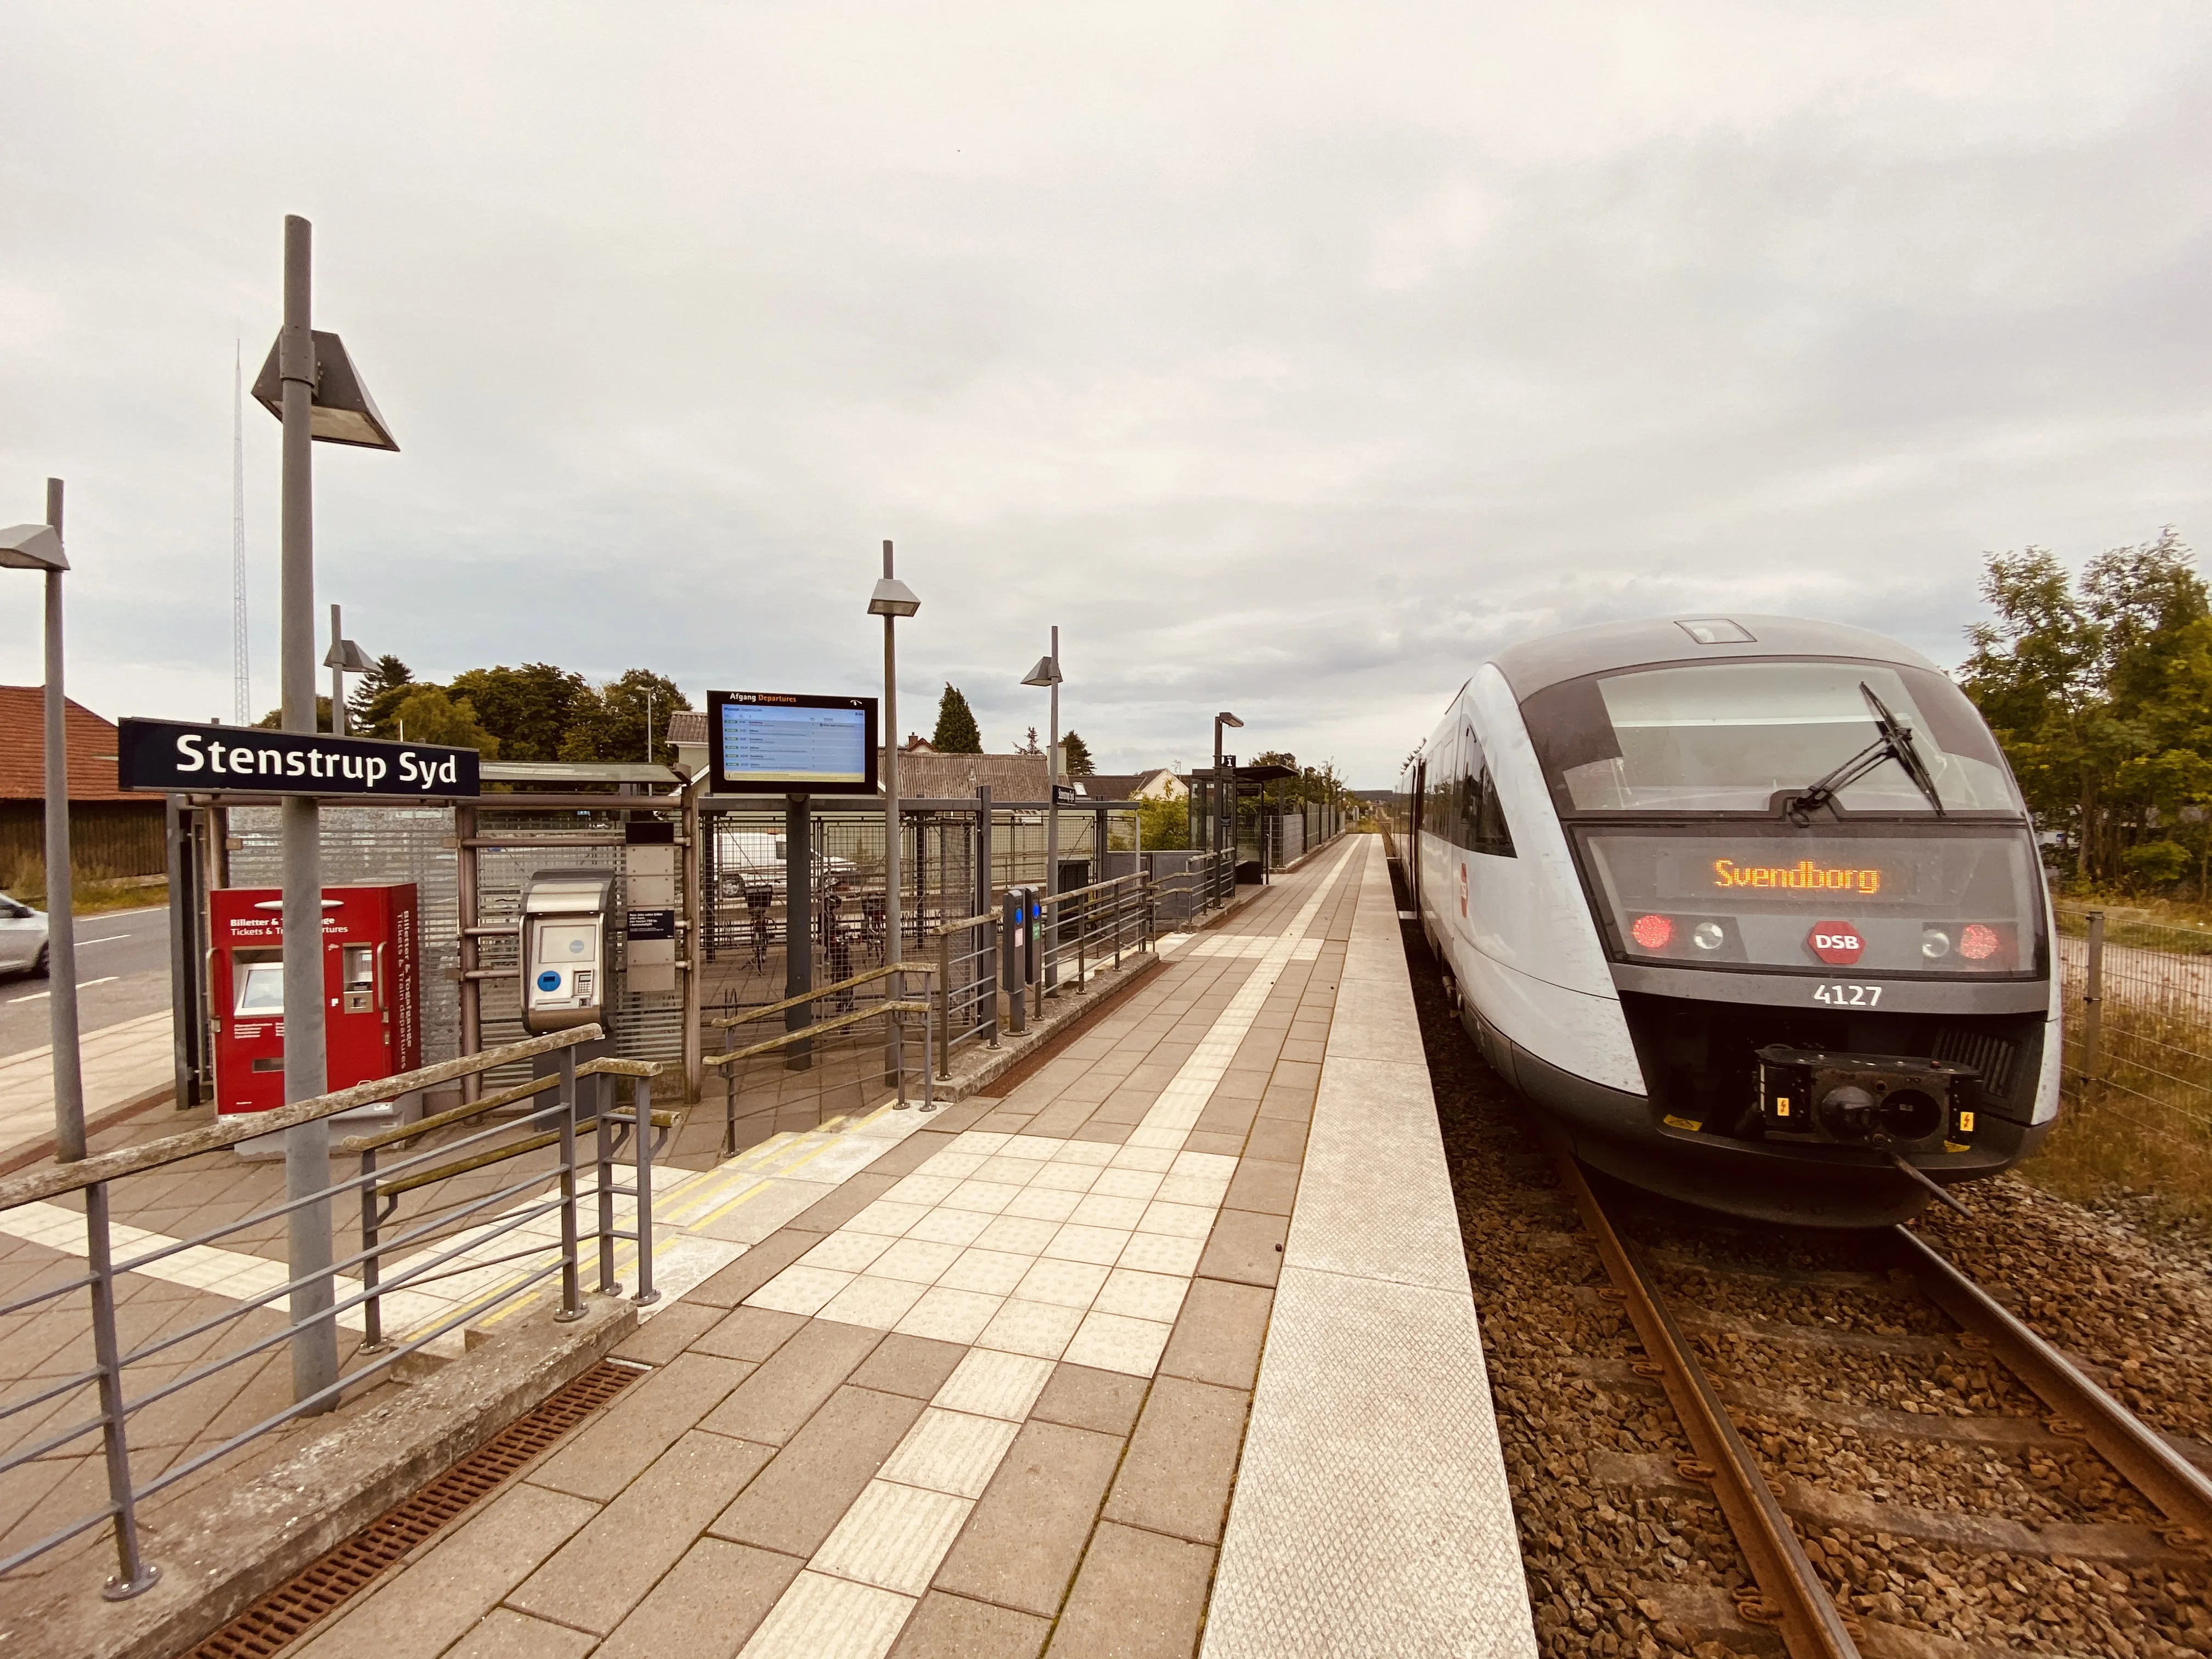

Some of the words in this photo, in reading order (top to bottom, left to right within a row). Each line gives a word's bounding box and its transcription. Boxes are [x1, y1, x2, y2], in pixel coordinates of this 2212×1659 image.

[730, 692, 756, 702] Afgang
[758, 694, 797, 703] Departures
[176, 733, 386, 787] Stenstrup
[398, 752, 457, 789] Syd
[1714, 859, 1881, 894] Svendborg
[230, 918, 269, 927] Billetter
[1815, 934, 1859, 950] DSB
[1813, 984, 1882, 1006] 4127
